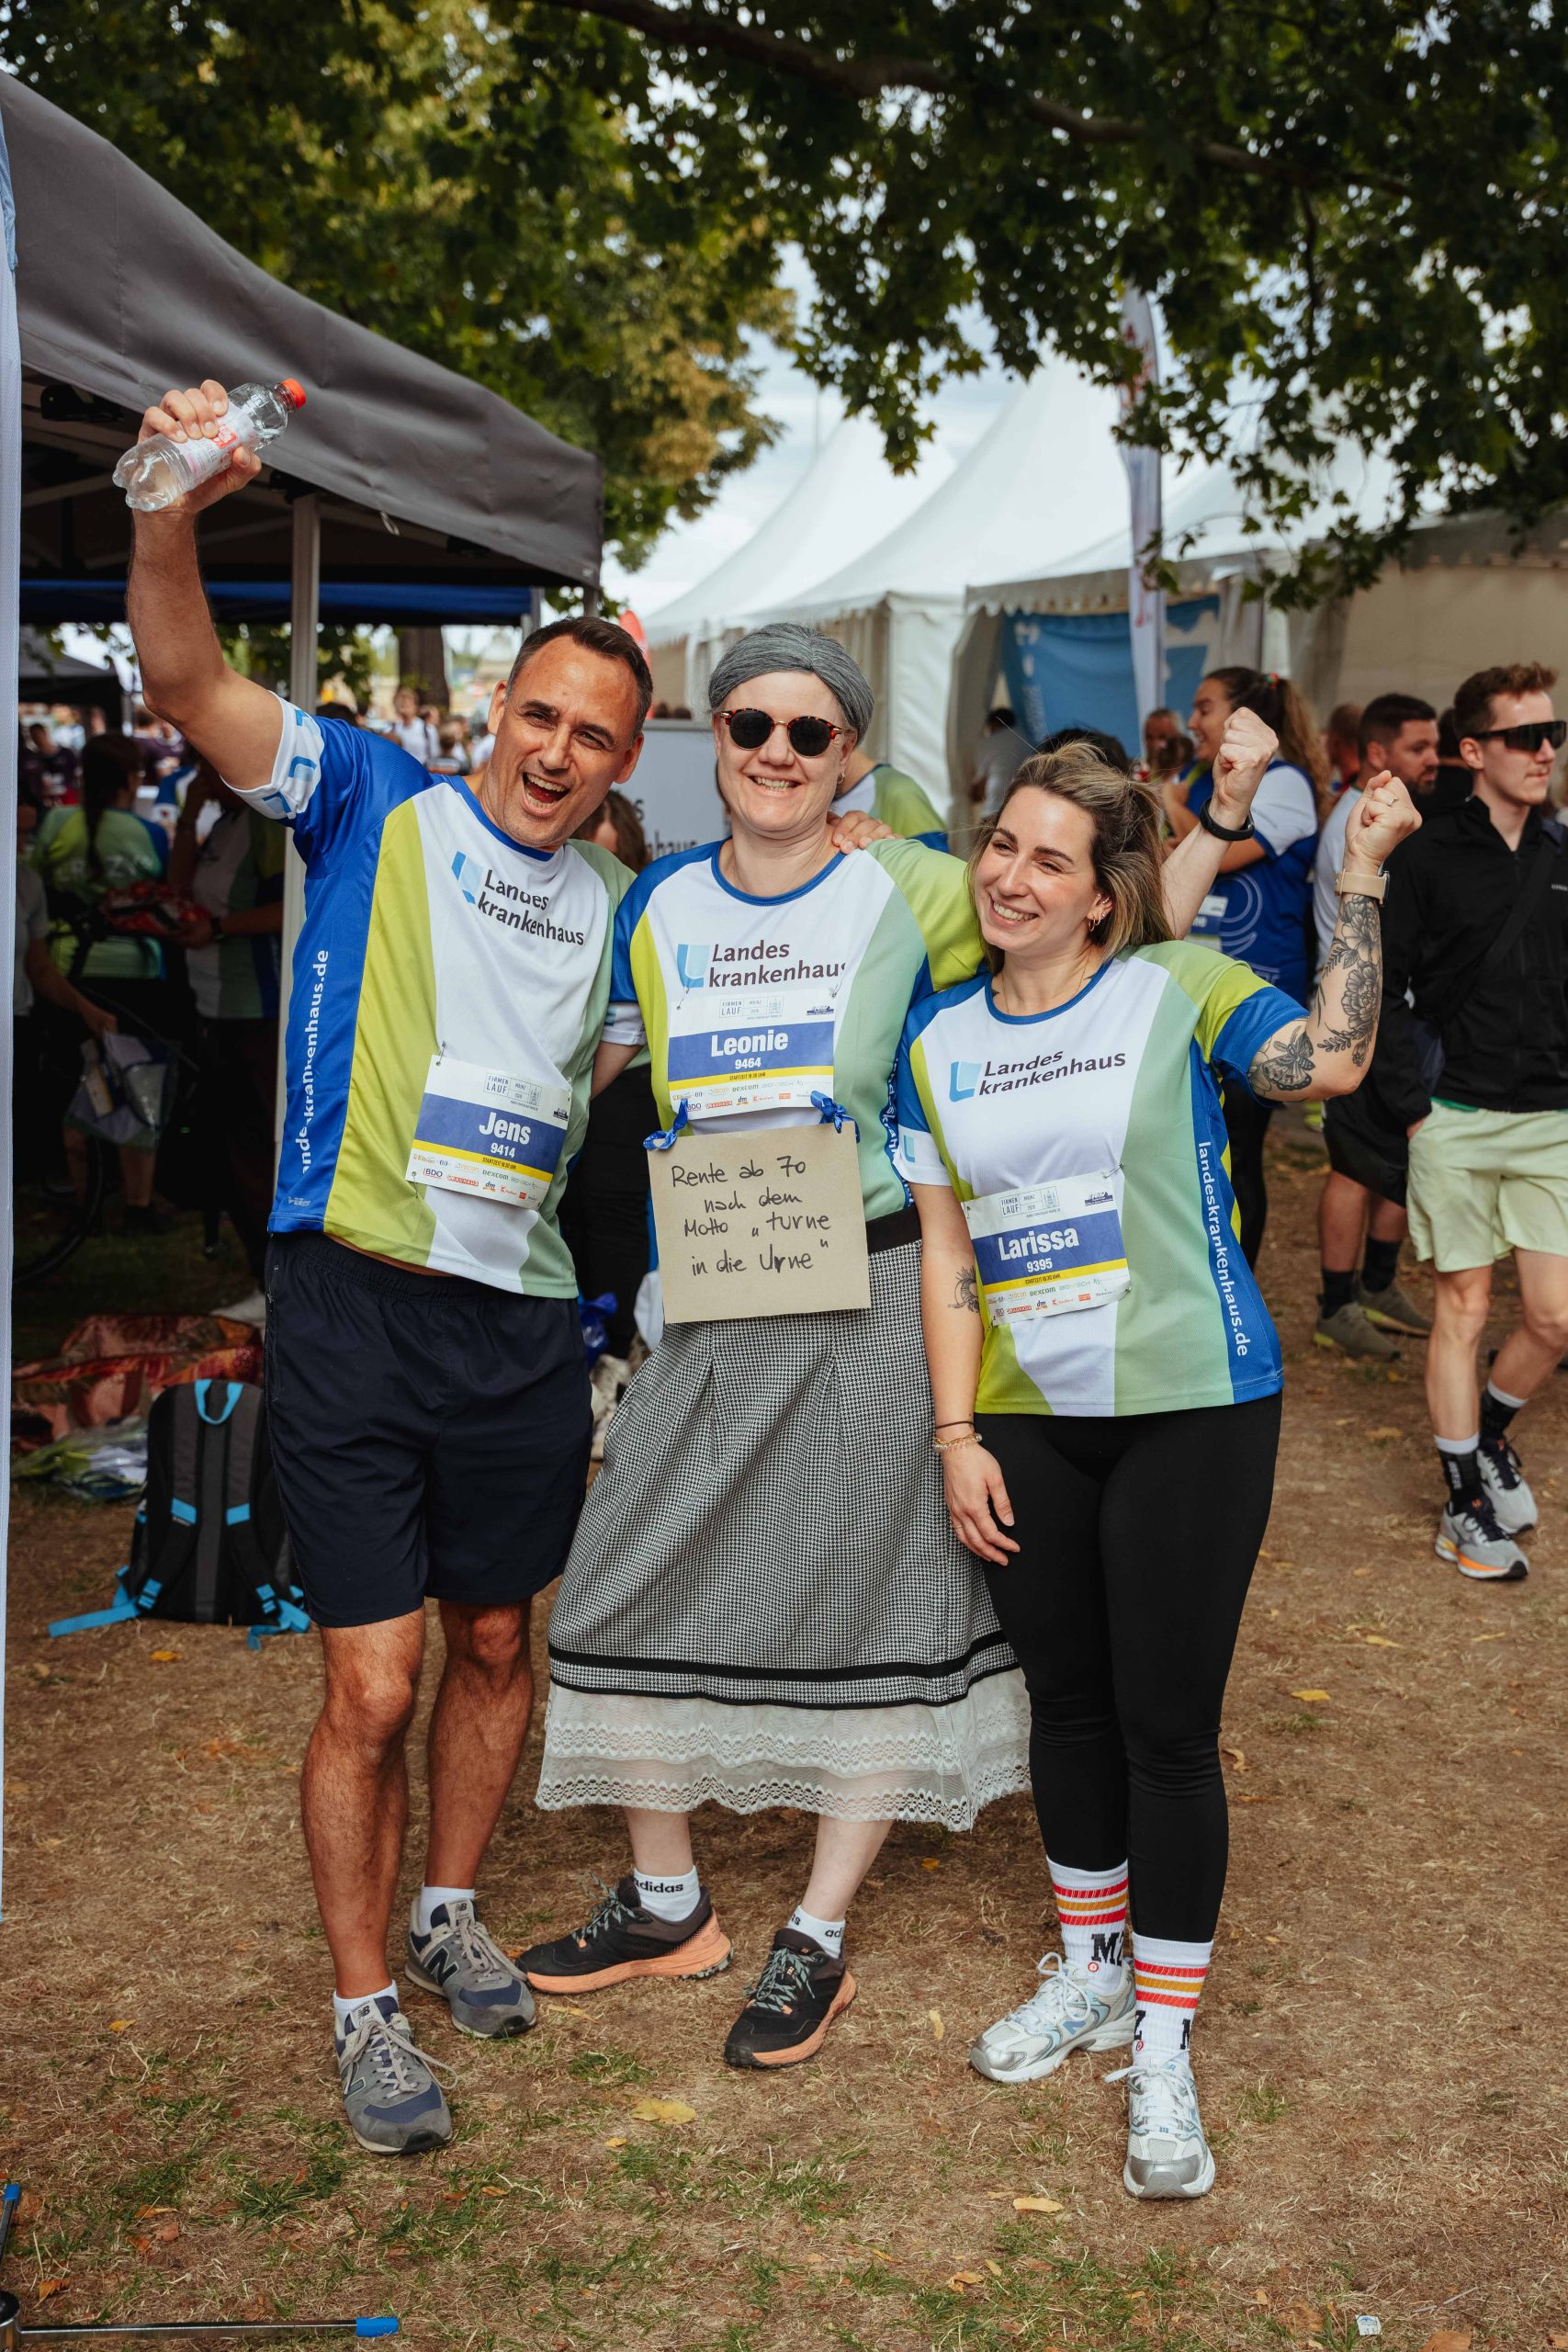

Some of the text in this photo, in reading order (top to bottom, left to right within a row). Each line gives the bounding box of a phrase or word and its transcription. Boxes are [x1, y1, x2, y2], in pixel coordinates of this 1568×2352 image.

[484, 869, 549, 910] Landes
[478, 891, 584, 945] krankenhaus
[712, 939, 790, 963] Landes
[721, 1006, 741, 1016] LAUF
[711, 1028, 789, 1057] Leonie
[734, 1057, 761, 1070] 9464
[978, 1052, 1126, 1096] krankenhaus
[984, 1050, 1064, 1077] Landes
[486, 1082, 508, 1094] LAUF
[479, 1112, 532, 1146] Jens
[490, 1142, 516, 1159] 9414
[426, 1168, 443, 1177] BDO
[671, 1155, 807, 1187] Rente ab 70
[704, 1186, 803, 1213] nach dem
[1002, 1204, 1020, 1216] LAUF
[683, 1217, 728, 1237] Motto
[998, 1227, 1079, 1261] Larissa
[1198, 1141, 1251, 1357] landeskrankenhaus.de
[692, 1256, 708, 1276] in
[716, 1249, 747, 1273] die
[1026, 1258, 1054, 1273] 9395
